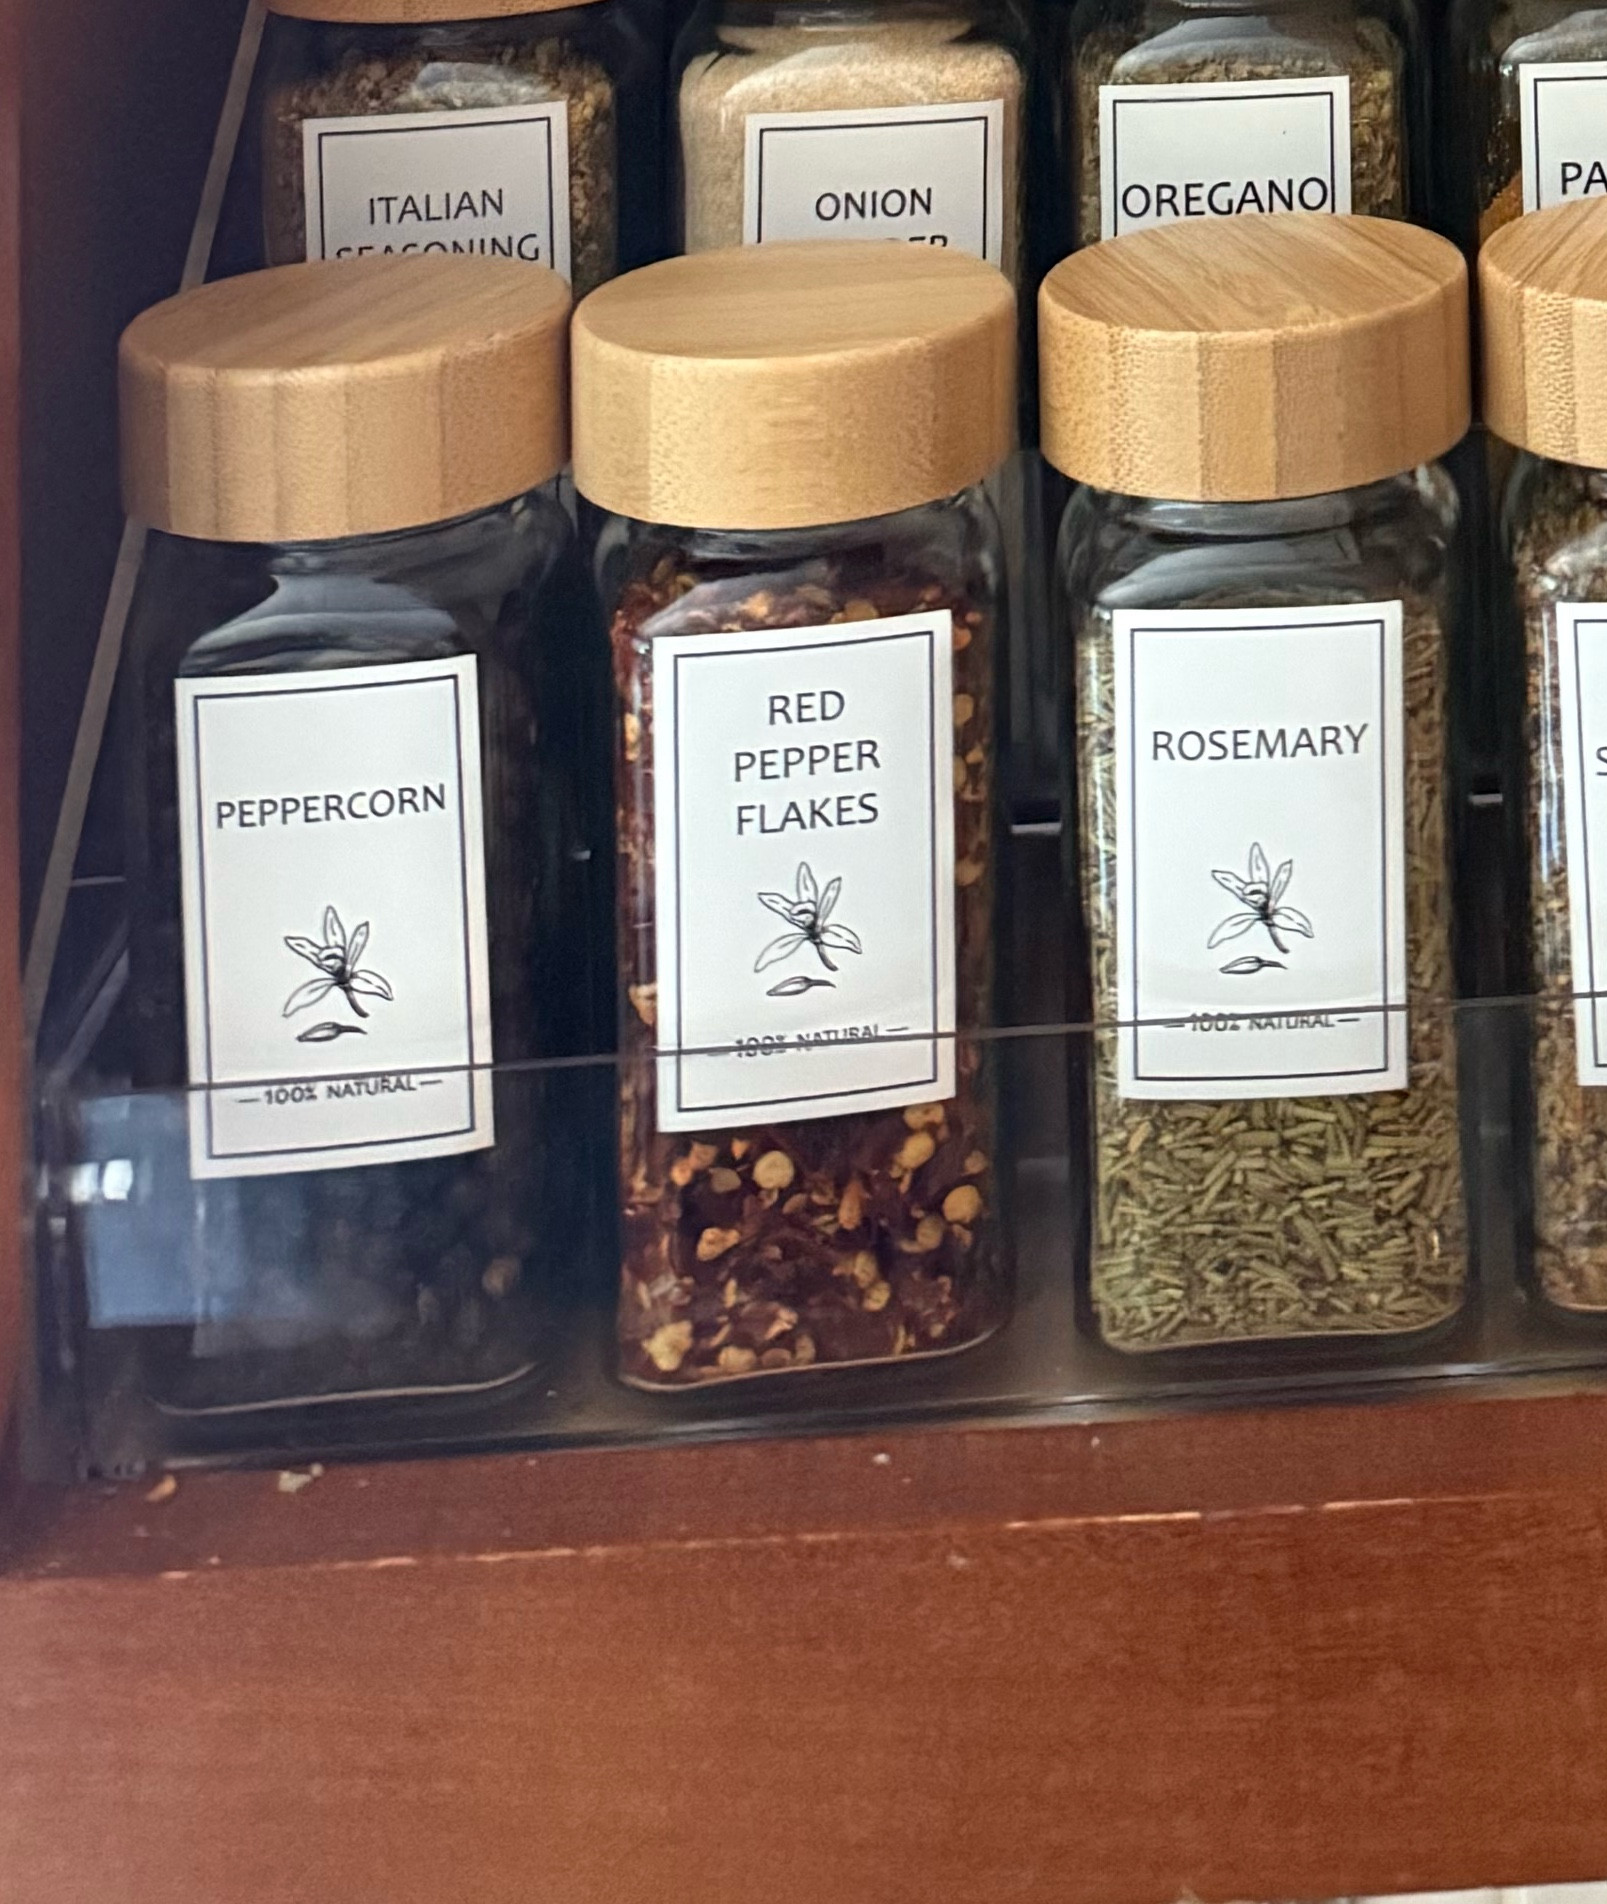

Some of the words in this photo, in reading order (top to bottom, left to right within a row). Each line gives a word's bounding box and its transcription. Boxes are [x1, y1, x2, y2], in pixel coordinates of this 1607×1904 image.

[369, 188, 504, 226] ITALIAN
[815, 187, 932, 221] ONION
[1121, 176, 1328, 218] OREGANO
[768, 690, 845, 726] RED
[733, 739, 881, 783] PEPPER
[1152, 723, 1370, 762] ROSEMARY
[215, 783, 447, 830] PEPPERCORN
[736, 792, 880, 836] FLAKES
[264, 1087, 318, 1104] 100%
[327, 1074, 416, 1099] NATURAL
